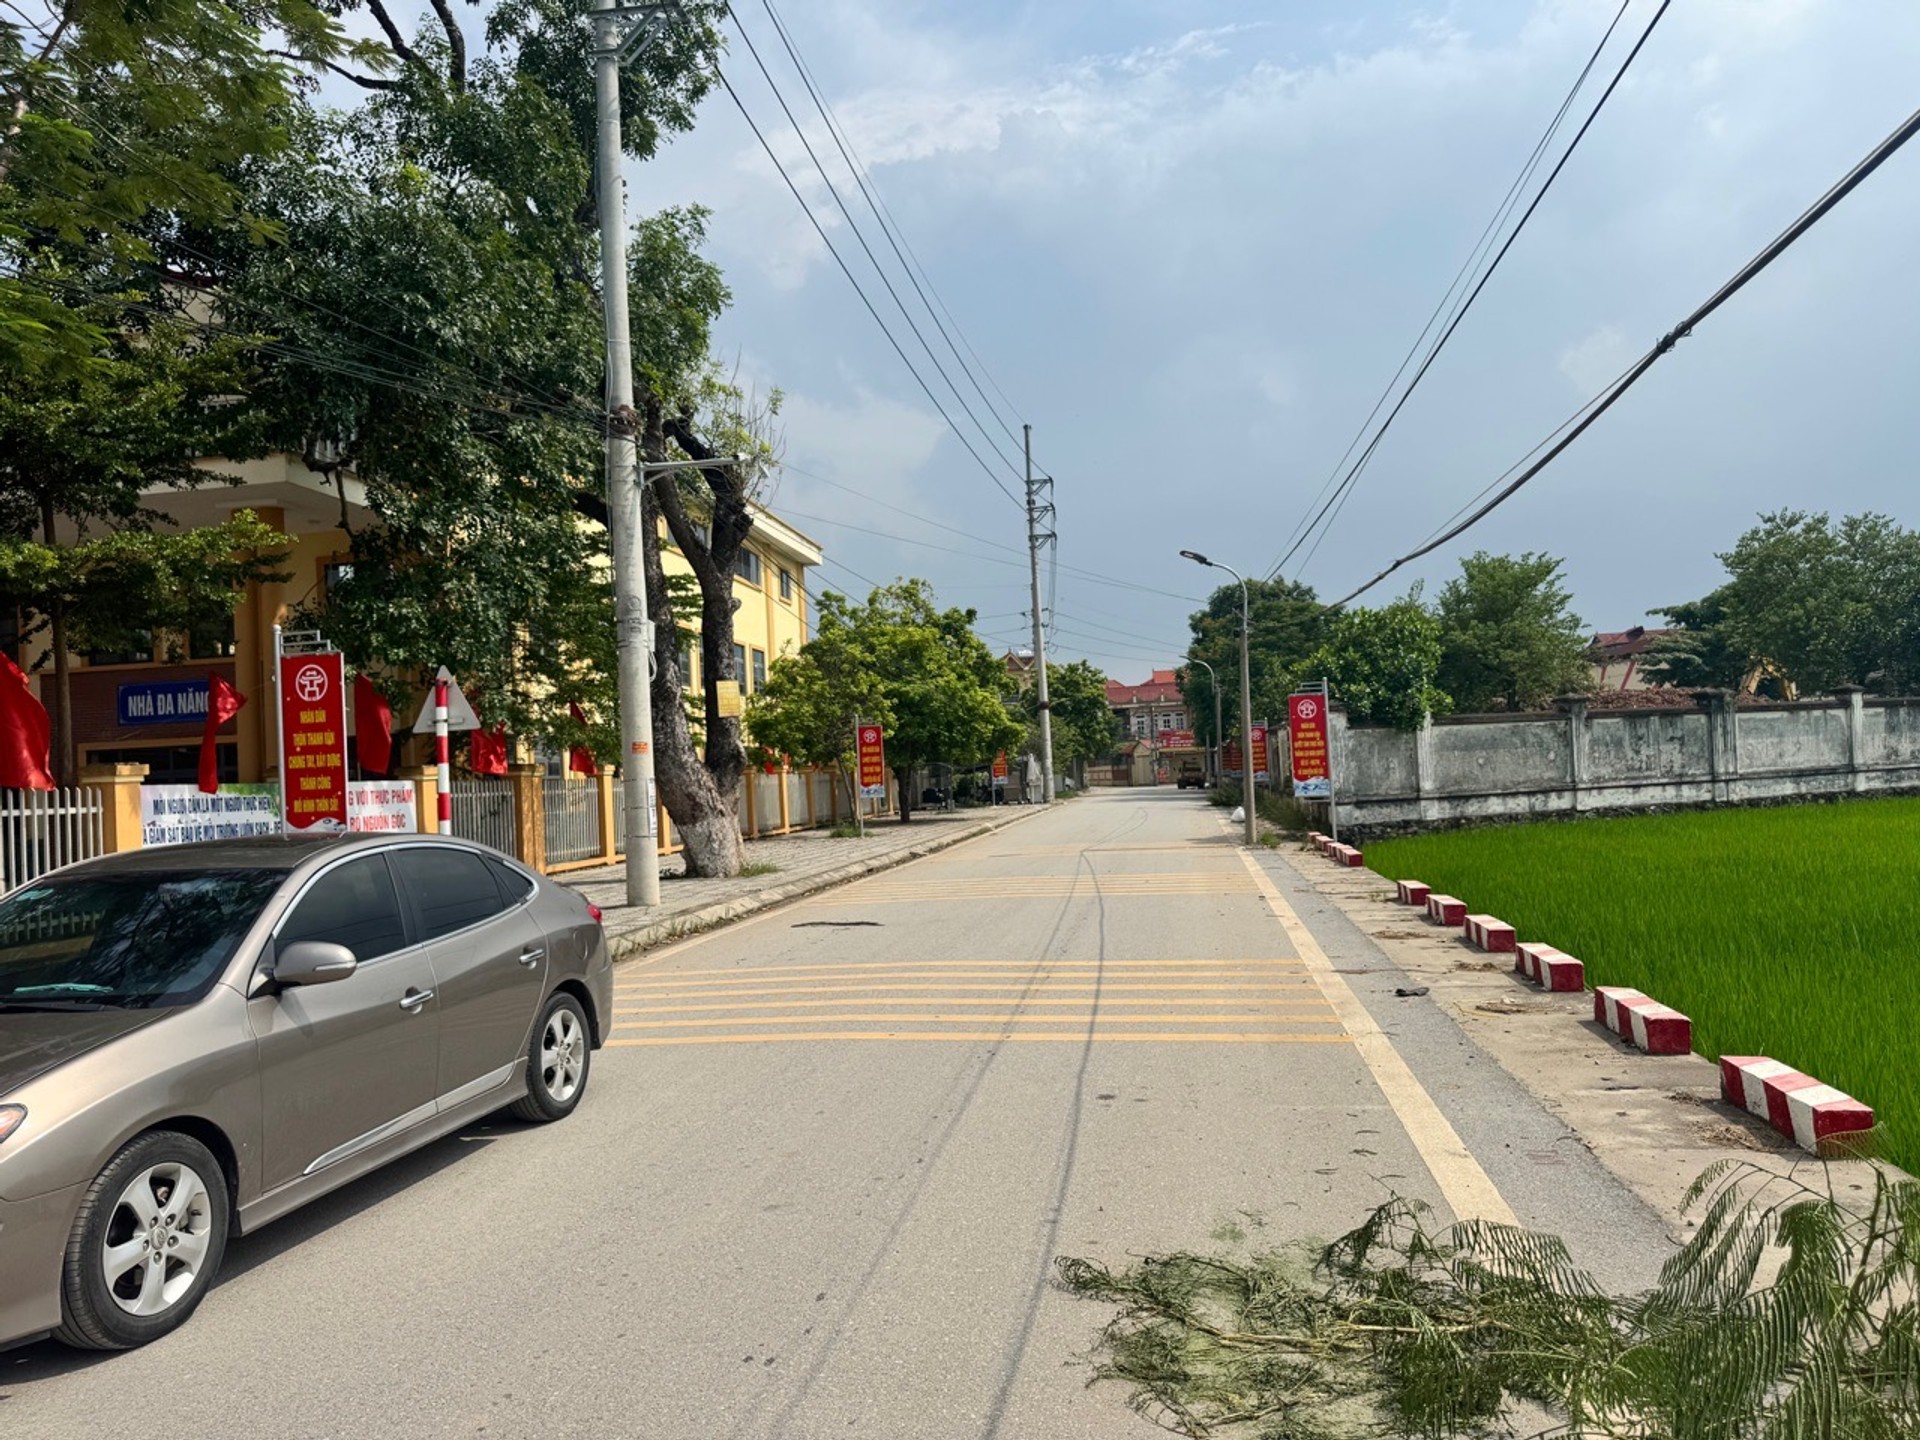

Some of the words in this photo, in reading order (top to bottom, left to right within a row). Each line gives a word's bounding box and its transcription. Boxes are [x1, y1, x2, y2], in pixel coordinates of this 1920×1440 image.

[128, 690, 154, 717] NHÀ
[157, 693, 175, 715] ĐA
[370, 788, 389, 807] THỰC
